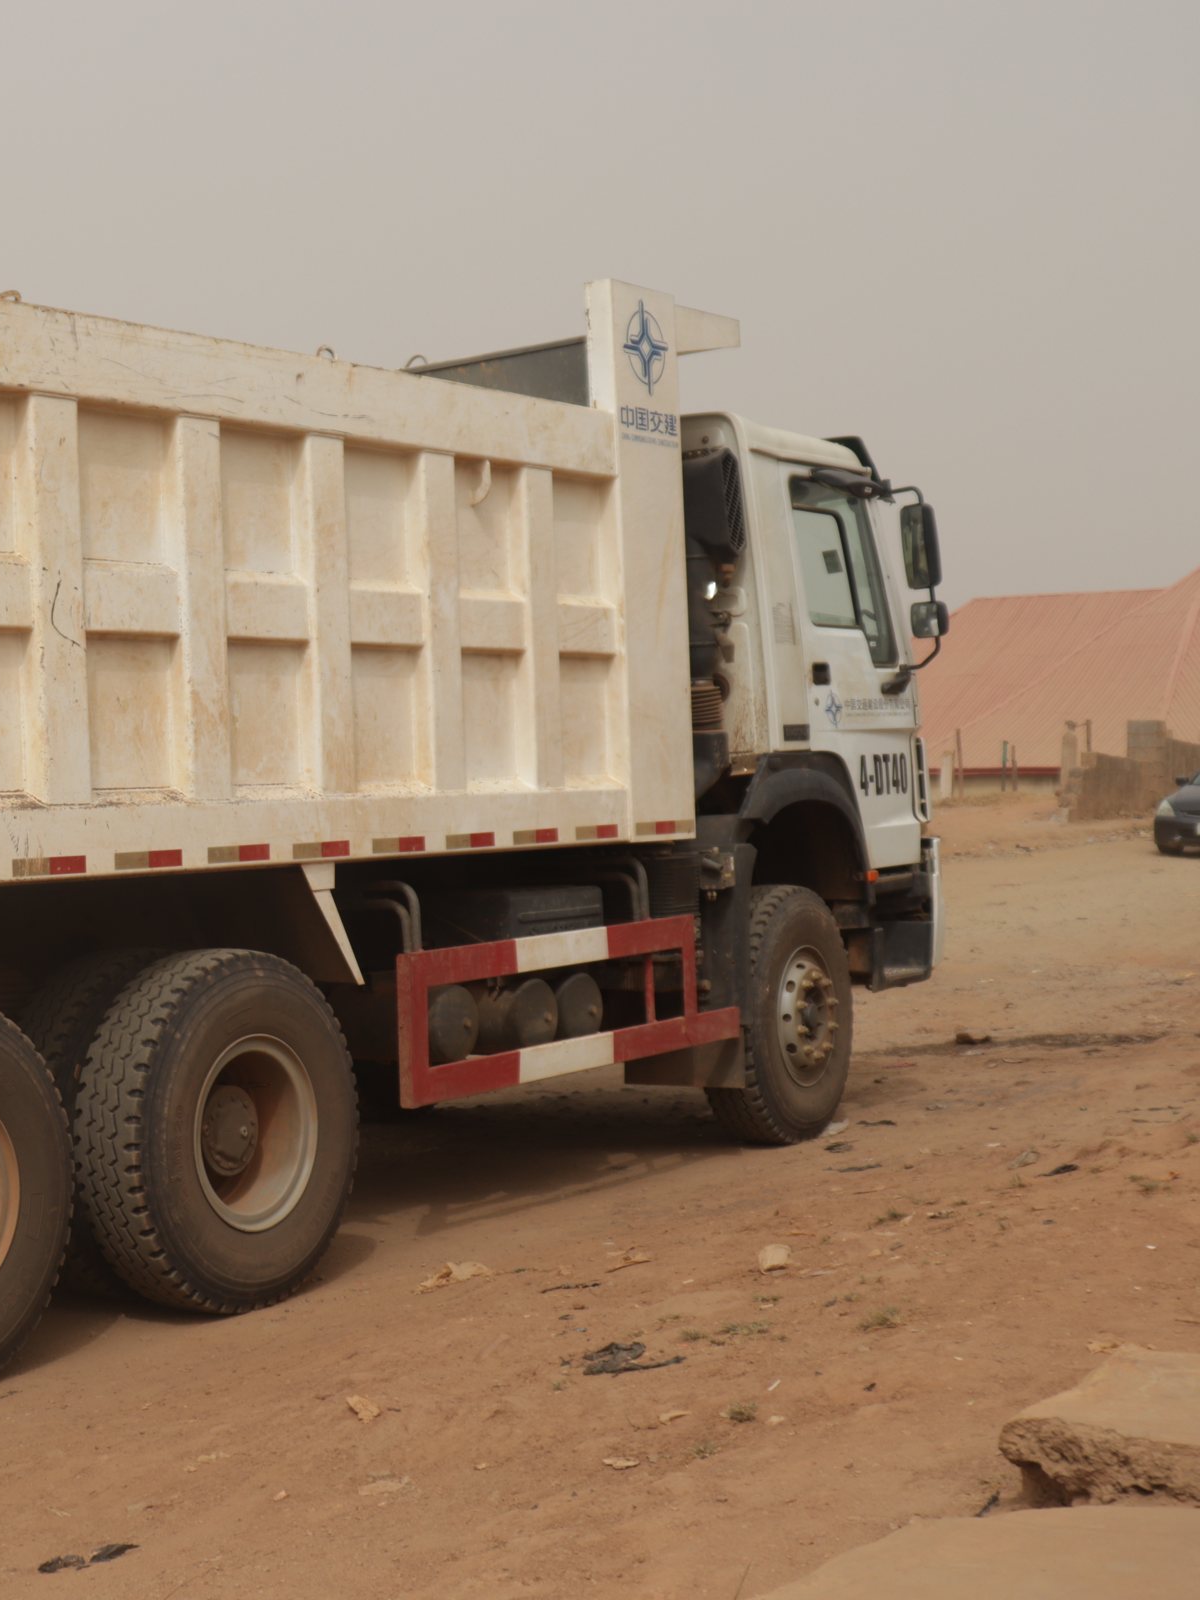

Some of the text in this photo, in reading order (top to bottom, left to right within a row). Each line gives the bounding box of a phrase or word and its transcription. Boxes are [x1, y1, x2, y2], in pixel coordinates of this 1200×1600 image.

[620, 405, 678, 436] 中国交建
[860, 752, 908, 796] 4-DT40
